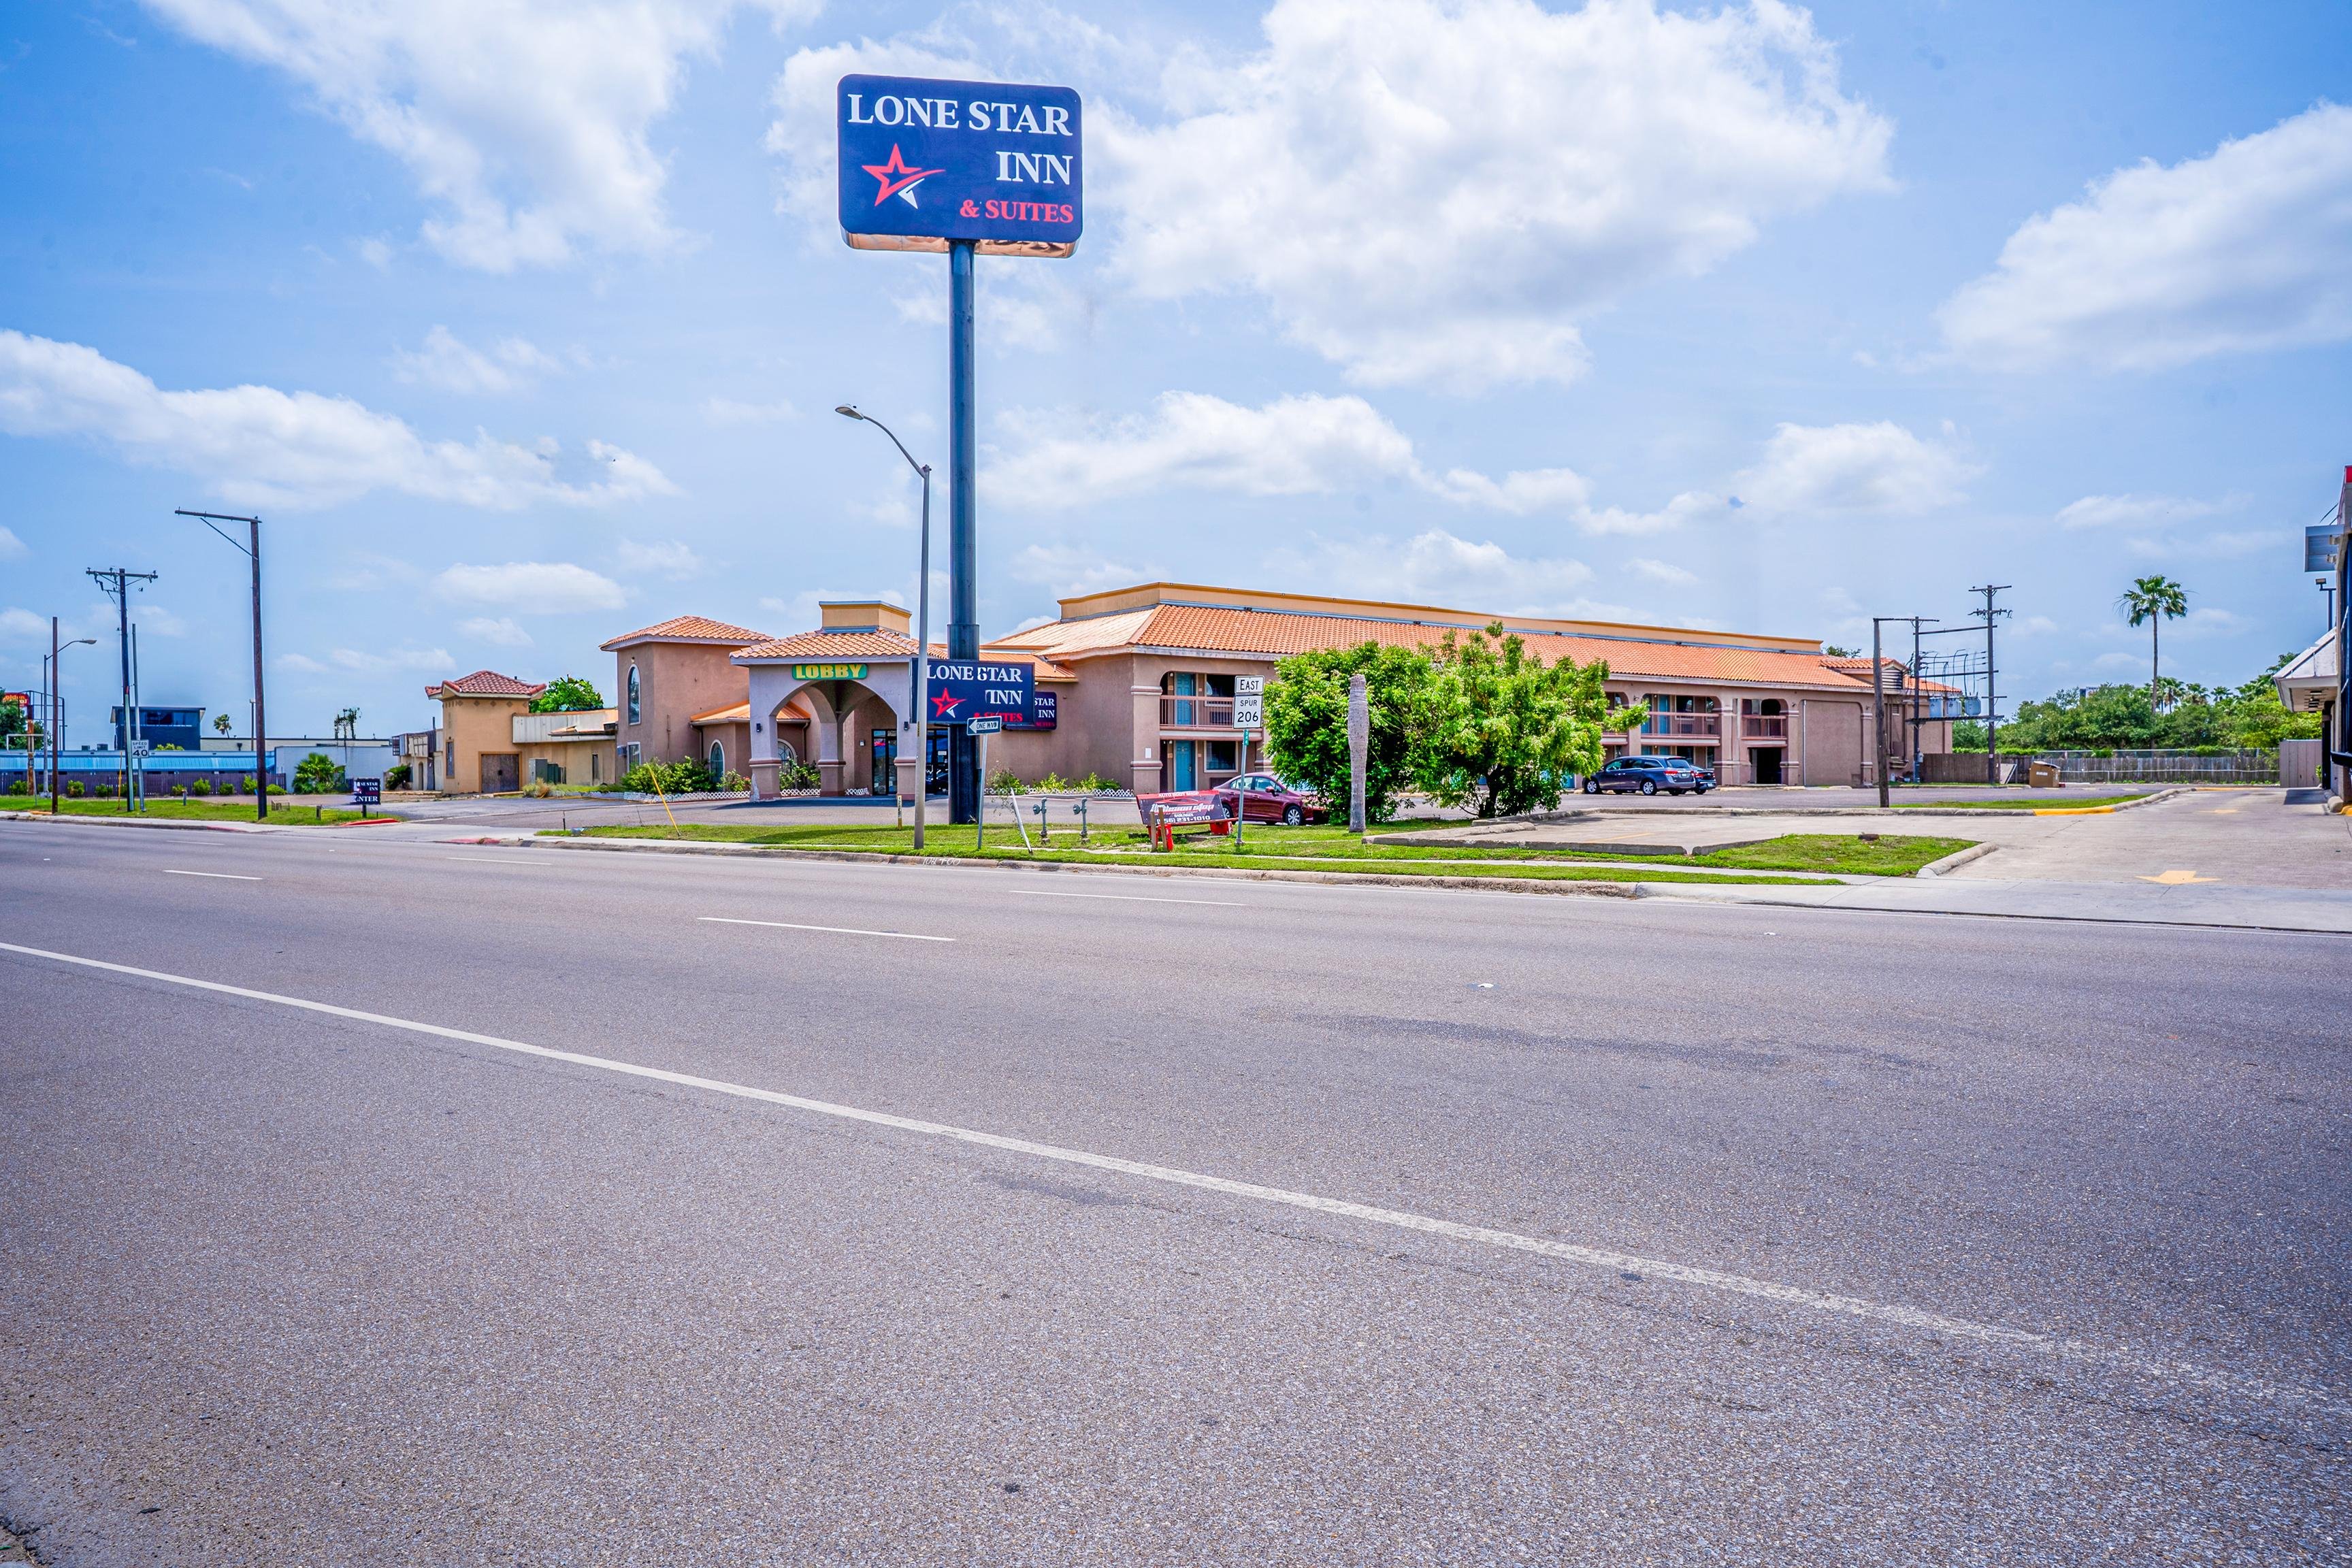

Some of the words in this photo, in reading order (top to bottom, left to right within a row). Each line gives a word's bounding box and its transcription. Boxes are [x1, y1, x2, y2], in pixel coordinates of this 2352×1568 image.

[847, 93, 960, 129] LONE
[968, 101, 1073, 136] STAR
[995, 150, 1073, 185] INN
[959, 199, 980, 218] &
[985, 199, 1074, 223] SUITES
[796, 664, 862, 679] LOBBY
[926, 665, 974, 681] LONE
[977, 667, 1023, 682] STAR
[1240, 679, 1259, 690] EAST
[987, 689, 1023, 704] INN
[1034, 698, 1055, 706] STAR
[1038, 709, 1055, 718] INN
[1237, 711, 1258, 722] 206
